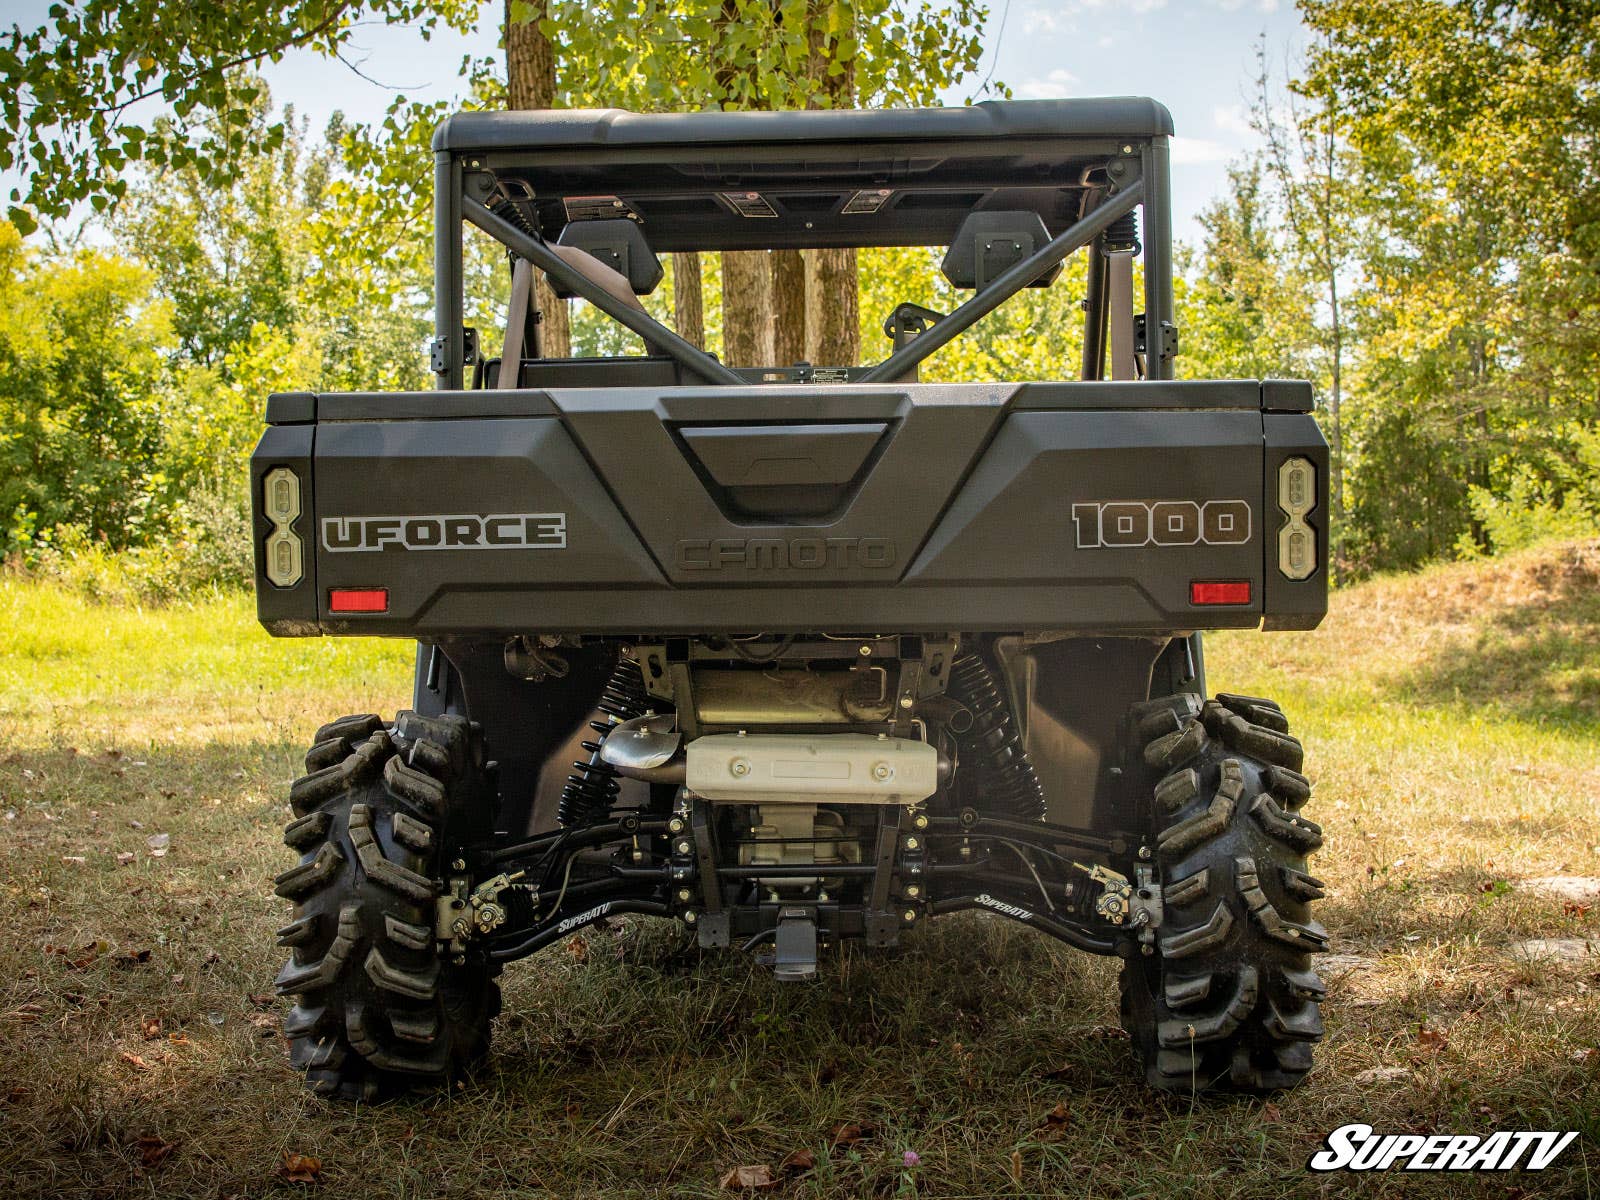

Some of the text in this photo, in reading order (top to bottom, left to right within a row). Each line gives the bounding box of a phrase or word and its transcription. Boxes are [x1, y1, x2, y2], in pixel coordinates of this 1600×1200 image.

[321, 513, 567, 553] UFORCE
[1071, 499, 1252, 549] 1000
[675, 538, 897, 570] CFMOTO
[558, 901, 611, 933] SUPERATV
[974, 893, 1033, 920] SUPERATV
